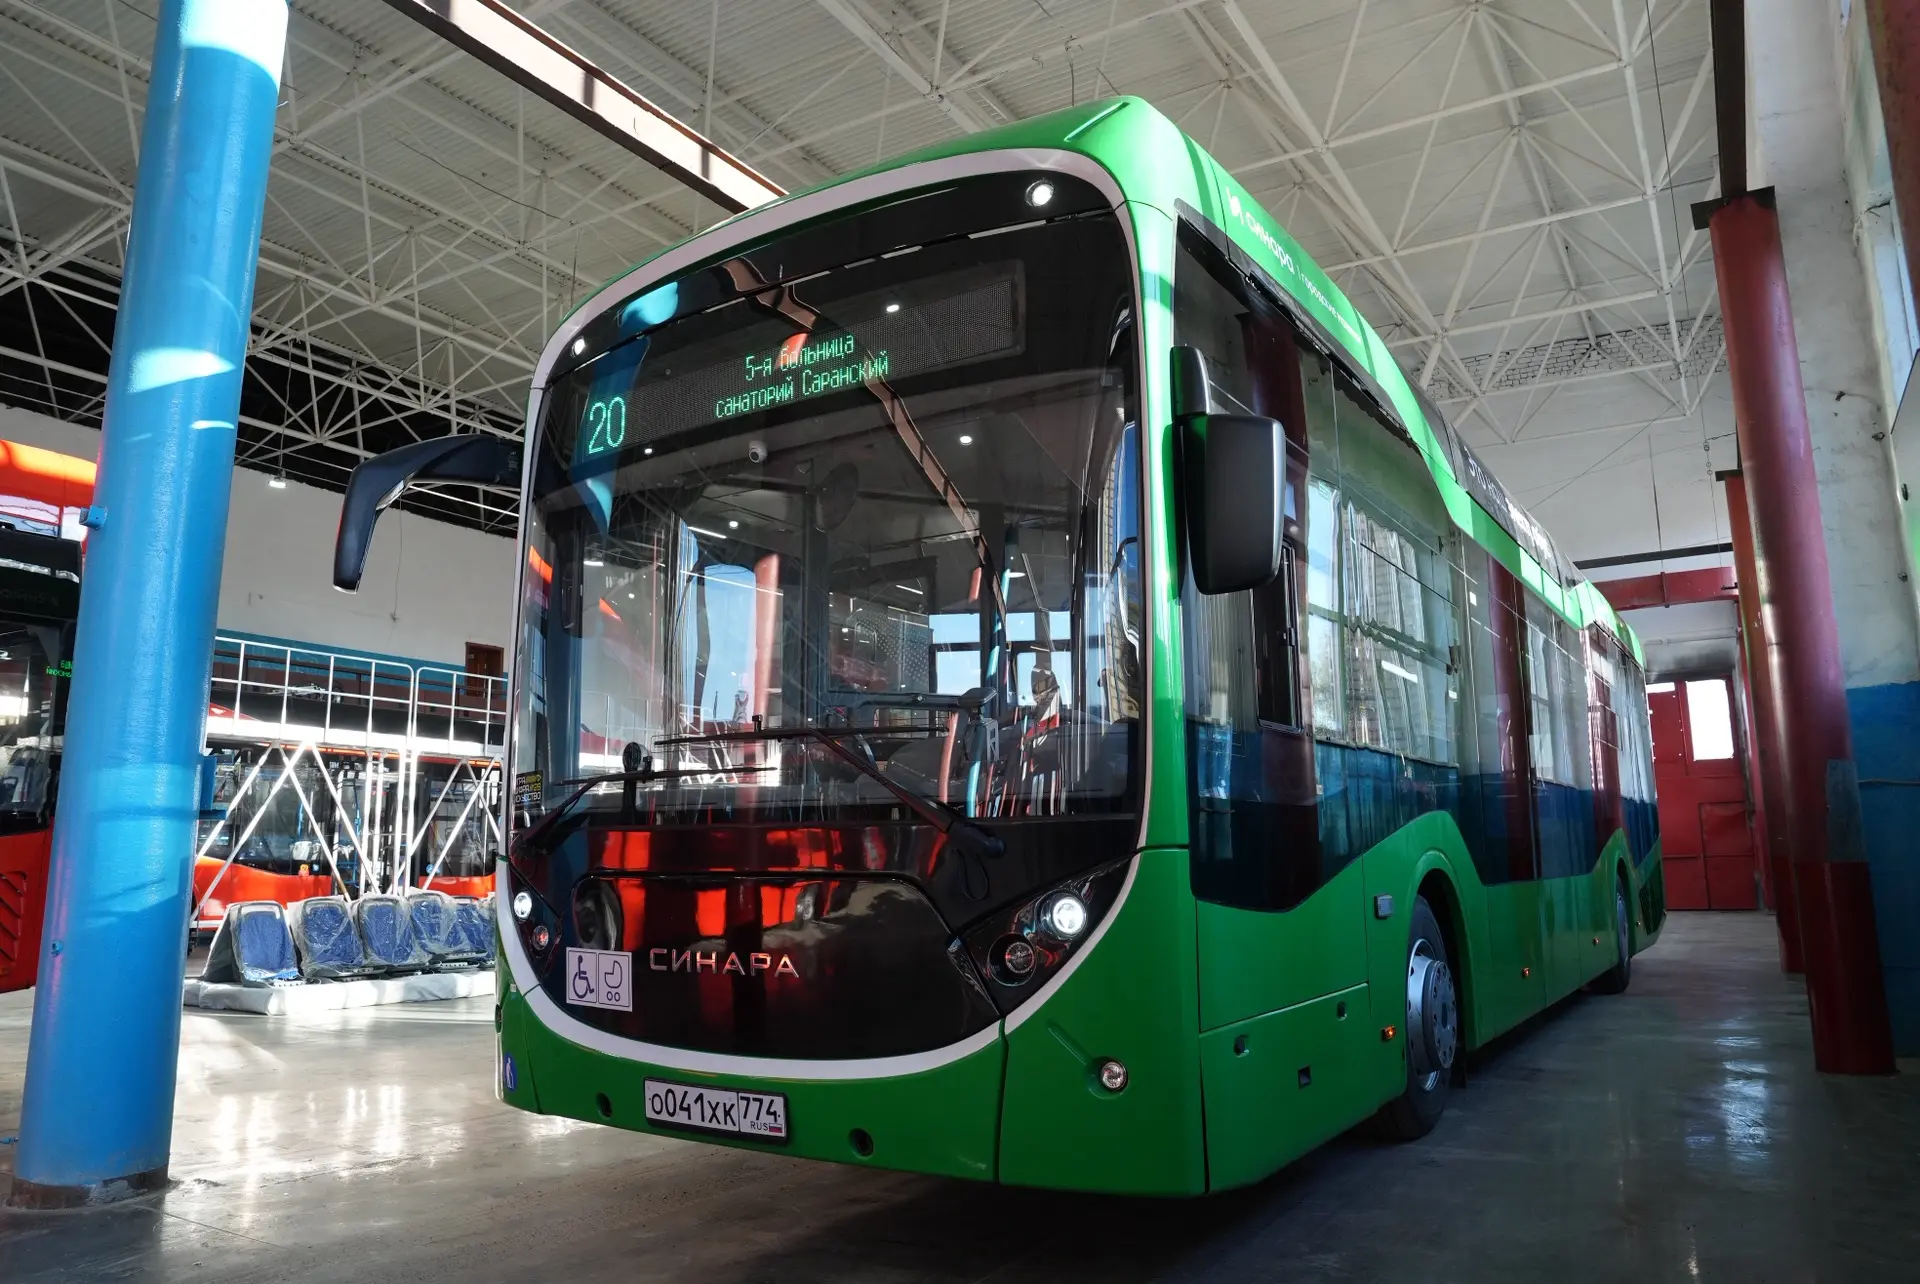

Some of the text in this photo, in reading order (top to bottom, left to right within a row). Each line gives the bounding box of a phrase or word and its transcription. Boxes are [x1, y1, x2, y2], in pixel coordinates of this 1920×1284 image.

[745, 334, 854, 381] 5-я больница
[716, 350, 889, 419] санаторий Саранский
[588, 396, 626, 454] 20
[649, 948, 800, 978] СИНАРА
[651, 1088, 778, 1127] О041ХК 774
[750, 1121, 769, 1131] RUS
